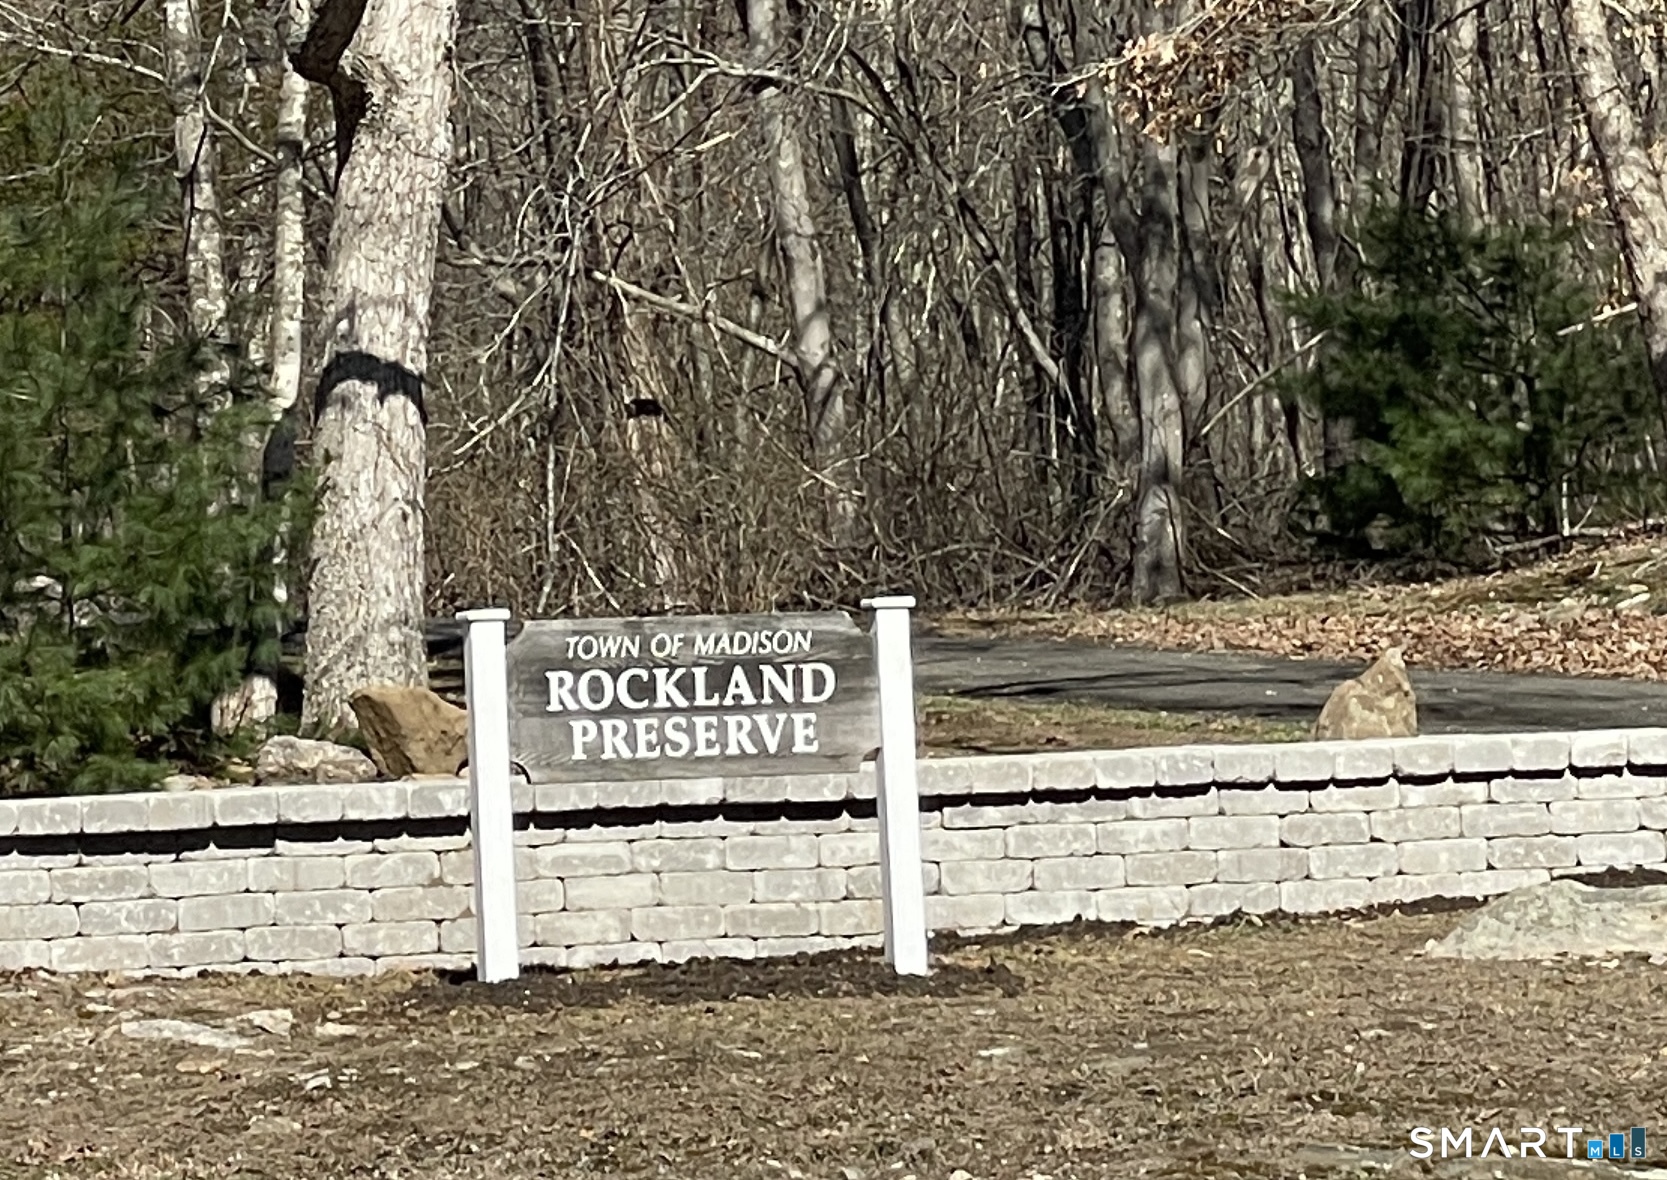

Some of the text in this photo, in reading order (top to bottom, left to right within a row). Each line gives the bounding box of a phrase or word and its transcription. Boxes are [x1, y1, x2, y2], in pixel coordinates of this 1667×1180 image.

[565, 630, 813, 660] TOWN OF MADISON
[545, 662, 836, 712] ROCKLAND
[568, 712, 819, 760] PRESERVE
